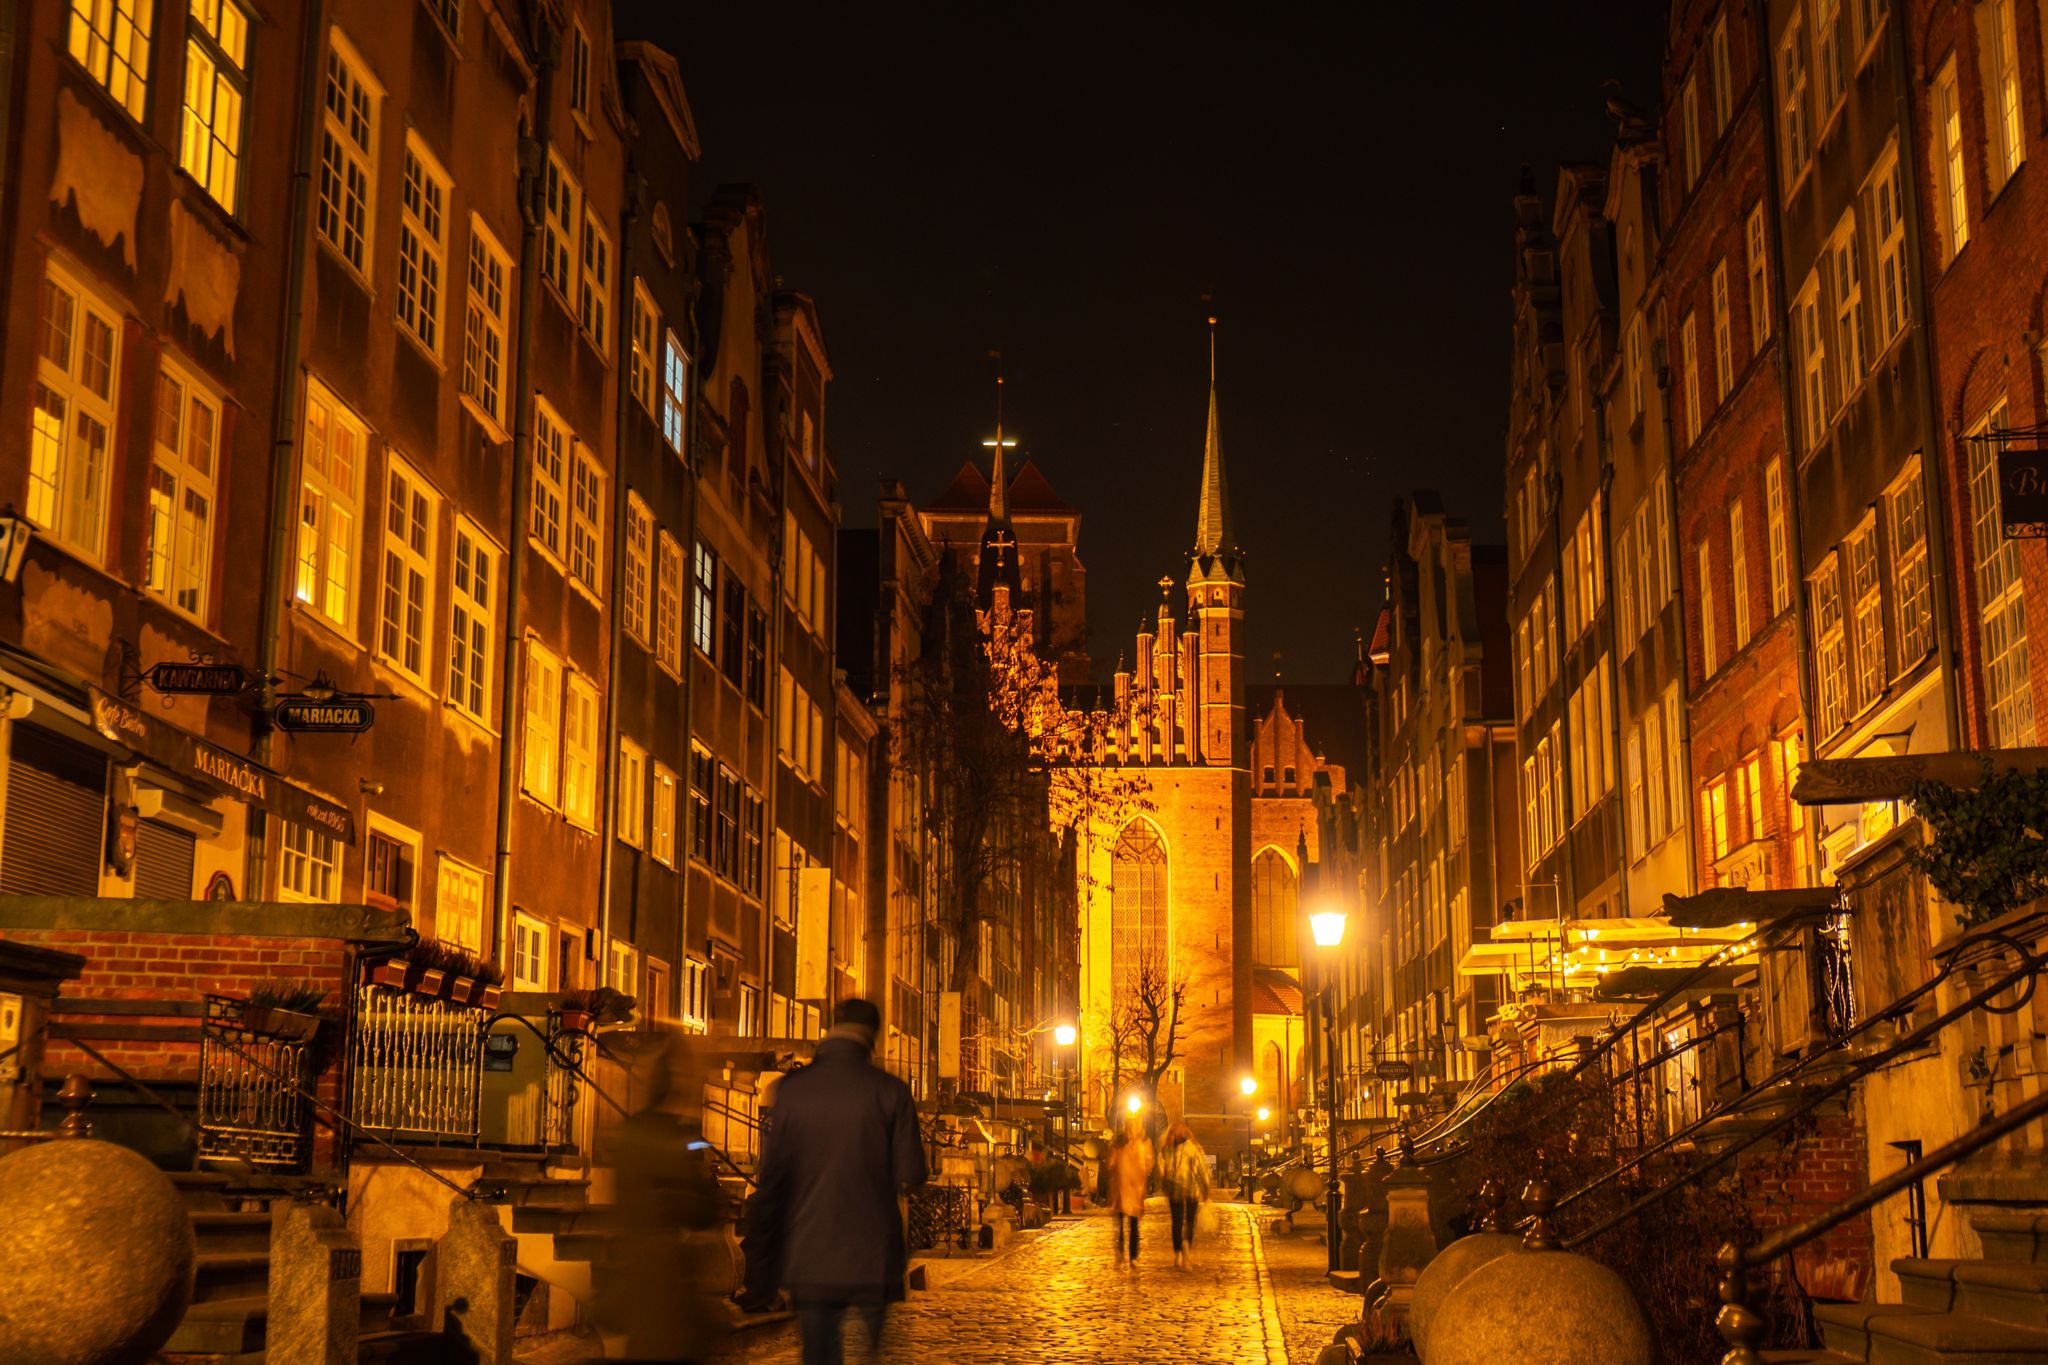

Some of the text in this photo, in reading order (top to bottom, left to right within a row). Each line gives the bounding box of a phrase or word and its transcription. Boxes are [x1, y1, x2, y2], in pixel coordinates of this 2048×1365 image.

[119, 708, 146, 737] Bistro
[287, 707, 361, 724] MARIACKA
[194, 746, 265, 800] MARIACKA
